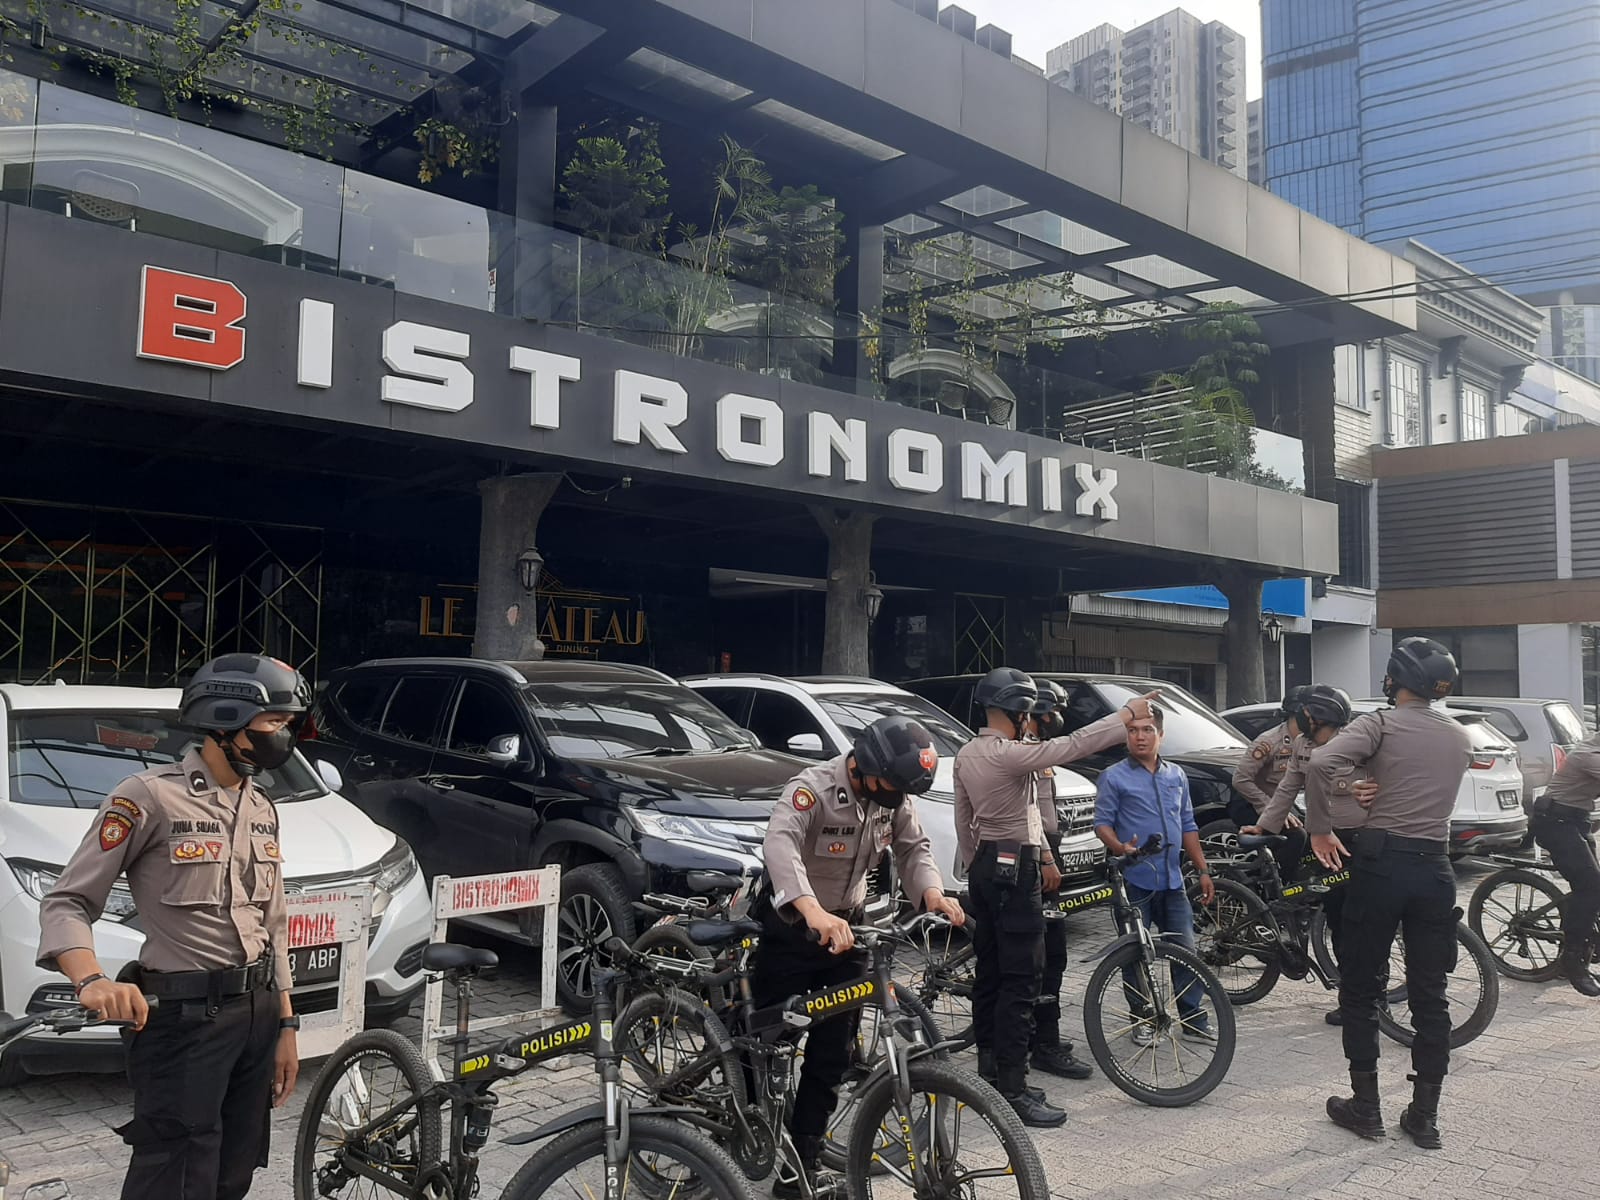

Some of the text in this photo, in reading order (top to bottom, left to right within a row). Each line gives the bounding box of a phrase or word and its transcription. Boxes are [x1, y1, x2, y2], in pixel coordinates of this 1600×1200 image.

[136, 264, 1120, 522] BISTRONOMIX
[419, 596, 464, 637] LE
[556, 644, 590, 654] DINING
[1321, 871, 1350, 885] POLIS
[452, 873, 540, 911] BISTRONOMIX
[1058, 892, 1096, 911] POLISI
[308, 947, 338, 970] ABP
[805, 987, 852, 1013] POLISI
[521, 1028, 568, 1057] POLISI
[899, 1115, 916, 1171] POLISI
